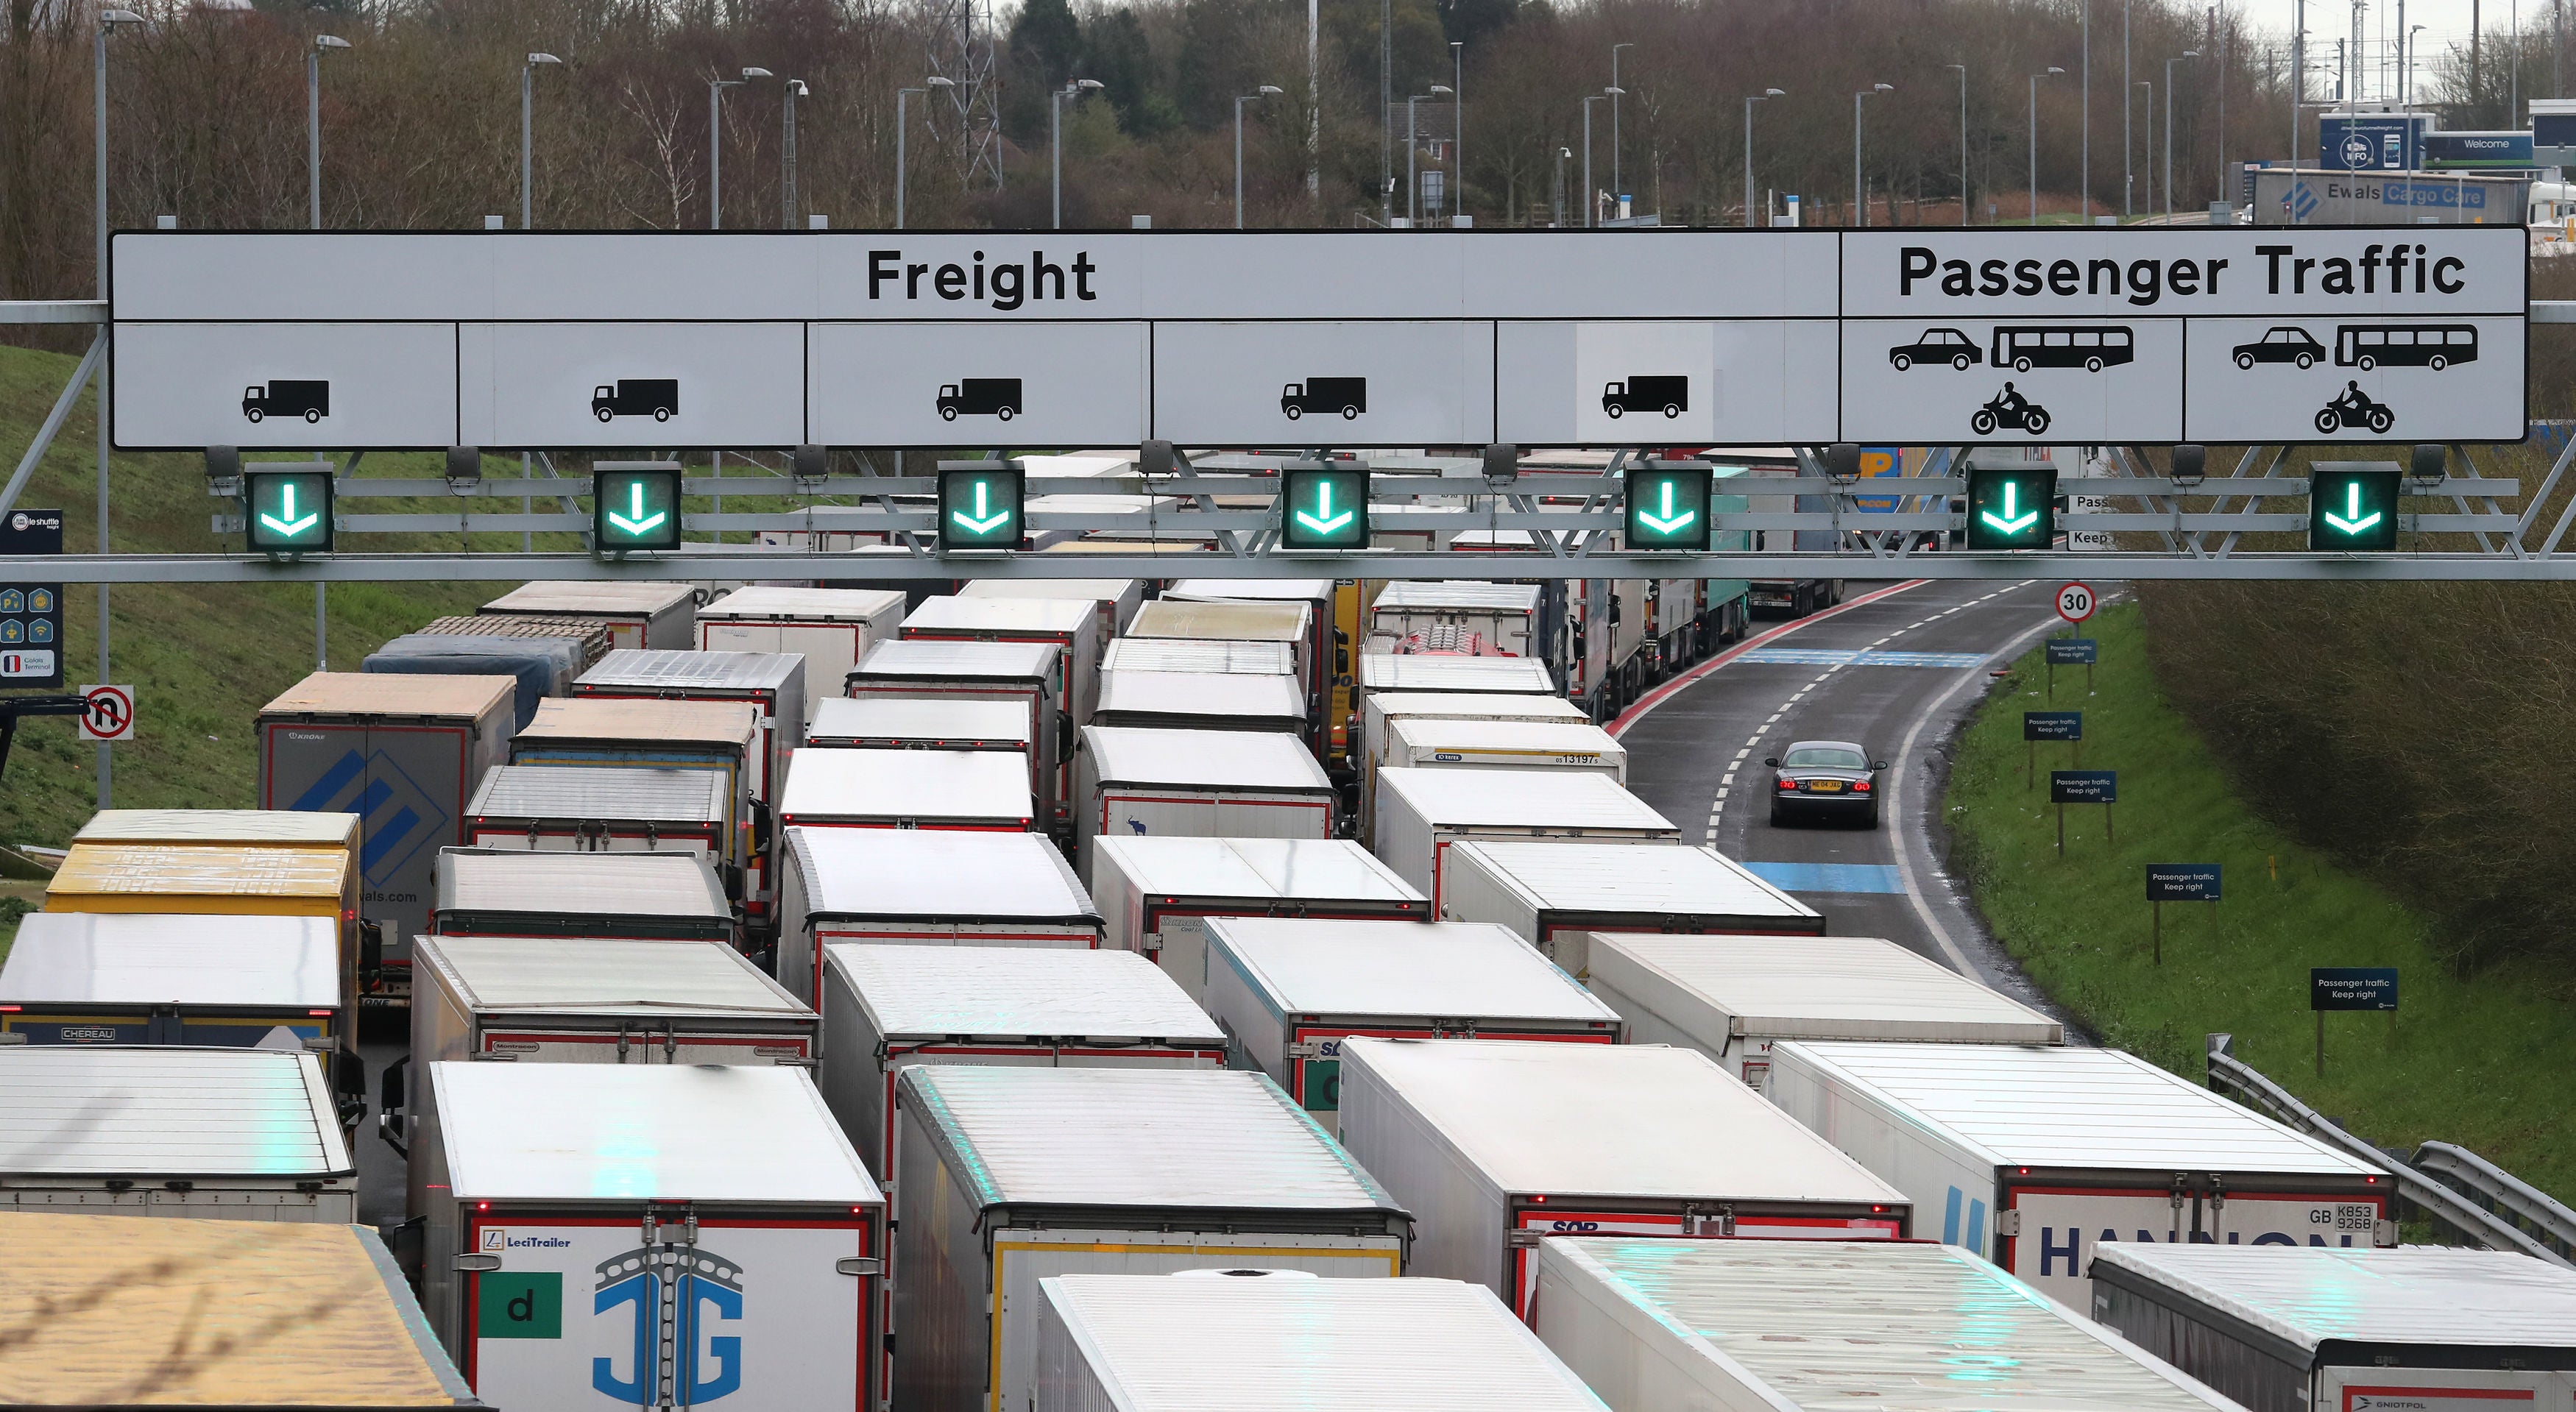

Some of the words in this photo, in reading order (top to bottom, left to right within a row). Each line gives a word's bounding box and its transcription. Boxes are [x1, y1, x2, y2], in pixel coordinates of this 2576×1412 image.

[2465, 140, 2509, 149] Welcome
[2328, 183, 2380, 199] Ewals
[2388, 185, 2437, 205] Cargo
[2442, 188, 2481, 204] Care
[868, 250, 1097, 311] Freight
[1900, 246, 2229, 307] Passenger
[2254, 244, 2466, 295] Traffic
[36, 517, 60, 525] shuttle
[2074, 533, 2108, 545] Keep
[2063, 594, 2087, 611] 30
[2153, 873, 2191, 881] Passenger
[2186, 884, 2203, 892] right
[2318, 979, 2363, 988] Passenger
[2365, 979, 2390, 987] traffic
[2332, 990, 2354, 999] Keep
[2357, 990, 2377, 1000] right
[63, 1030, 113, 1038] CHEREAU
[2310, 1210, 2332, 1224] GB
[2338, 1206, 2371, 1217] K853
[2338, 1218, 2371, 1229] 9268
[507, 1237, 571, 1247] LeciTrailer
[507, 1288, 534, 1321] d
